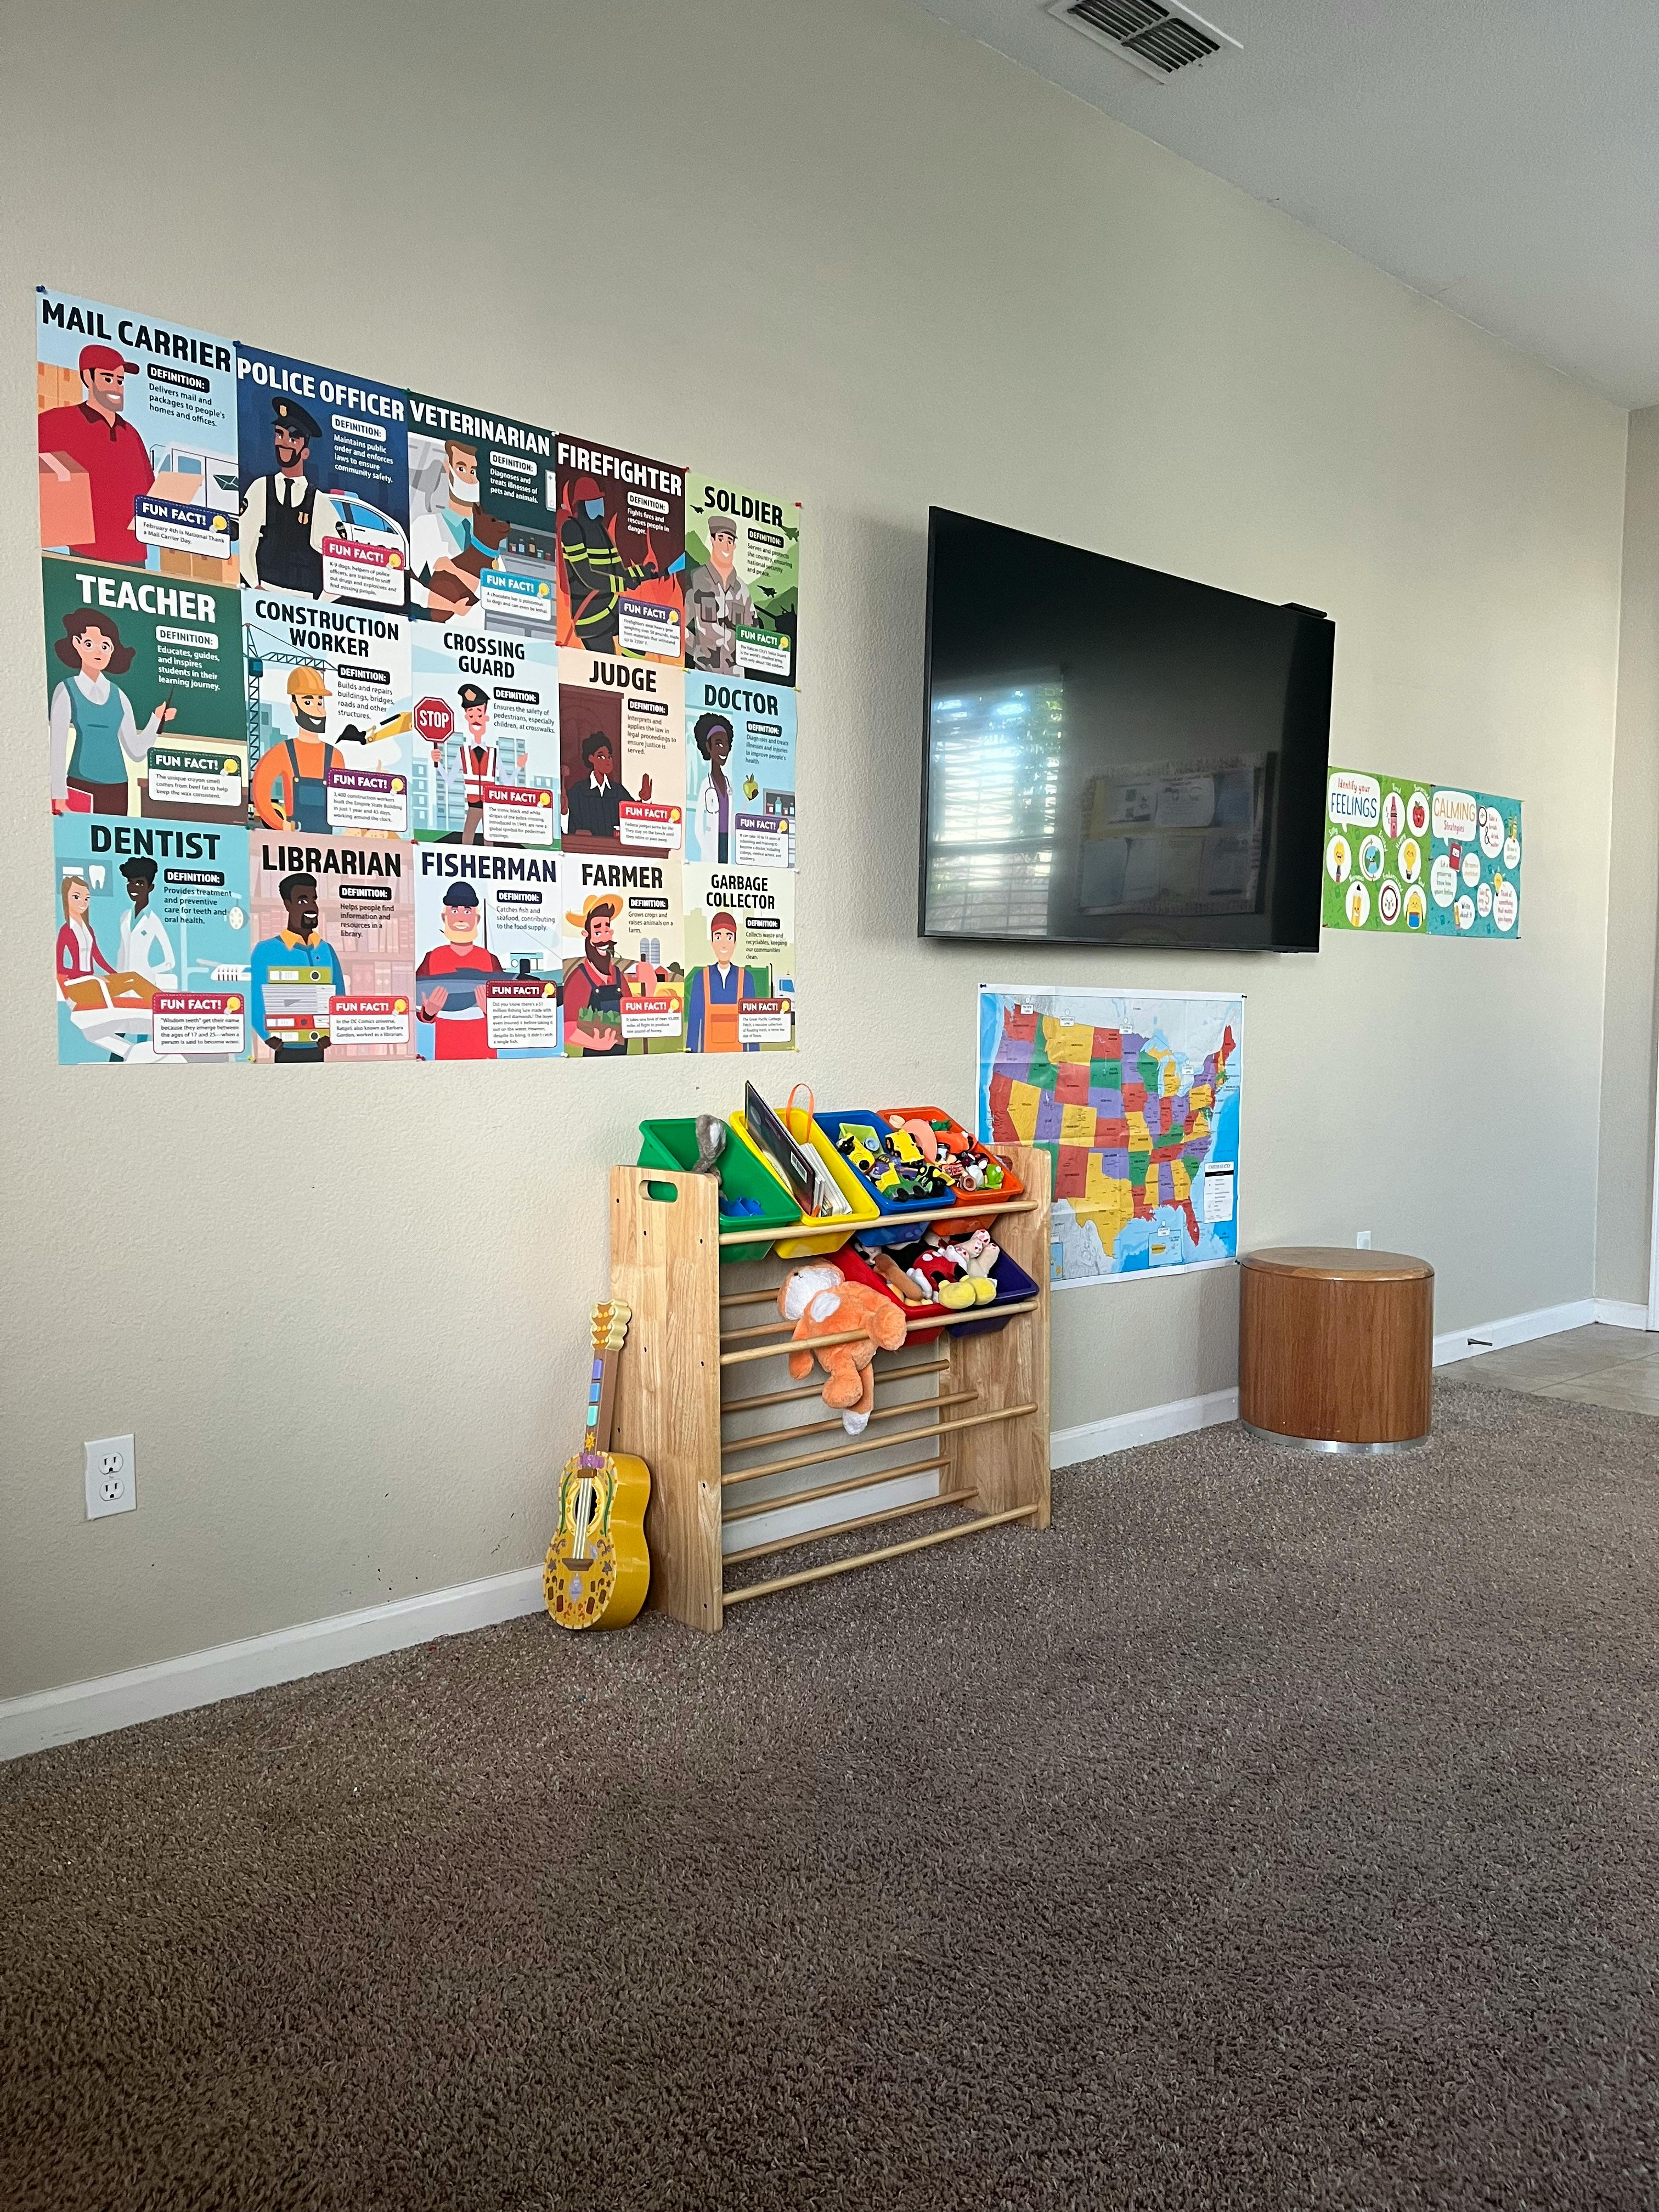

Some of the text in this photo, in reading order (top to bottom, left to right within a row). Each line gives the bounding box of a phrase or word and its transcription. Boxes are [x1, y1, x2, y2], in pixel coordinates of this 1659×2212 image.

[43, 299, 230, 372] MAIL CARRIER
[150, 368, 205, 389] DEFINITION:
[149, 383, 212, 405] Delivers mail and
[237, 357, 404, 421] POLICE OFFICER
[149, 396, 184, 408] packages
[195, 407, 224, 418] people's
[149, 404, 217, 426] homes and offices.
[336, 419, 381, 437] DEFINITION:
[410, 400, 550, 456] VETERINARIAN
[334, 435, 386, 453] Maintains public
[335, 445, 393, 464] order and enforces
[335, 453, 349, 462] laws
[359, 460, 380, 470] ensure
[493, 455, 533, 472] DEFINITION:
[558, 442, 681, 496] FIREFIGHTER
[335, 464, 392, 483] community safety.
[630, 495, 665, 510] DEFINITION:
[704, 486, 782, 527] SOLDIER
[143, 503, 206, 525] FUN FACT!
[144, 522, 167, 534] February
[185, 531, 208, 540] National
[209, 535, 224, 543] Thank
[161, 533, 178, 541] Carrier
[180, 537, 192, 545] Day.
[749, 531, 781, 545] DEFINITION:
[329, 543, 383, 563] FUN FACT!
[487, 575, 534, 592] FUN FACT!
[76, 574, 215, 623] TEACHER
[624, 603, 665, 619] FUN FACT!
[256, 600, 398, 641] CONSTRUCTION
[160, 630, 213, 645] DEFINITION:
[290, 628, 369, 657] WORKER
[741, 630, 777, 645] FUN FACT!
[158, 646, 219, 661] Educates, guides,
[444, 633, 524, 660] CROSSING
[174, 658, 202, 668] inspires
[459, 656, 515, 678] GUARD
[159, 667, 190, 675] students
[201, 672, 218, 680] their
[340, 667, 386, 681] DEFINITION:
[589, 661, 656, 692] JUDGE
[159, 676, 220, 691] learning journey.
[338, 681, 357, 690] Builds
[372, 687, 392, 696] repairs
[338, 691, 394, 706] buildings, bridges,
[495, 690, 536, 702] DEFINITION:
[705, 685, 778, 716] DOCTOR
[338, 710, 370, 719] structures.
[630, 701, 665, 713] DEFINITION:
[420, 710, 449, 728] STOP
[748, 724, 779, 735] DEFINITION:
[156, 754, 218, 770] FUN FACT!
[334, 775, 387, 789] FUN FACT!
[1338, 778, 1370, 794] Identify your
[489, 791, 535, 803] FUN FACT!
[1331, 793, 1377, 818] FEELINGS
[625, 807, 667, 819] FUN FACT!
[1434, 798, 1475, 822] CALMING
[741, 819, 776, 830] FUN FACT!
[1444, 820, 1464, 834] Strategies
[91, 825, 220, 860] DENTIST
[263, 845, 400, 877] LIBRARIAN
[422, 852, 556, 882] FISHERMAN
[167, 872, 219, 883] DEFINITION:
[582, 864, 663, 888] FARMER
[711, 874, 768, 891] GARBAGE
[342, 888, 387, 898] DEFINITION:
[499, 893, 539, 901] DEFINITION:
[707, 892, 775, 909] COLLECTOR
[180, 898, 217, 906] preventive
[630, 899, 665, 907] DEFINITION:
[492, 986, 511, 995] FUN
[160, 1000, 221, 1009] FUN FACT!
[336, 1003, 388, 1011] FUN FACT!
[626, 1002, 666, 1011] FUN FACT!
